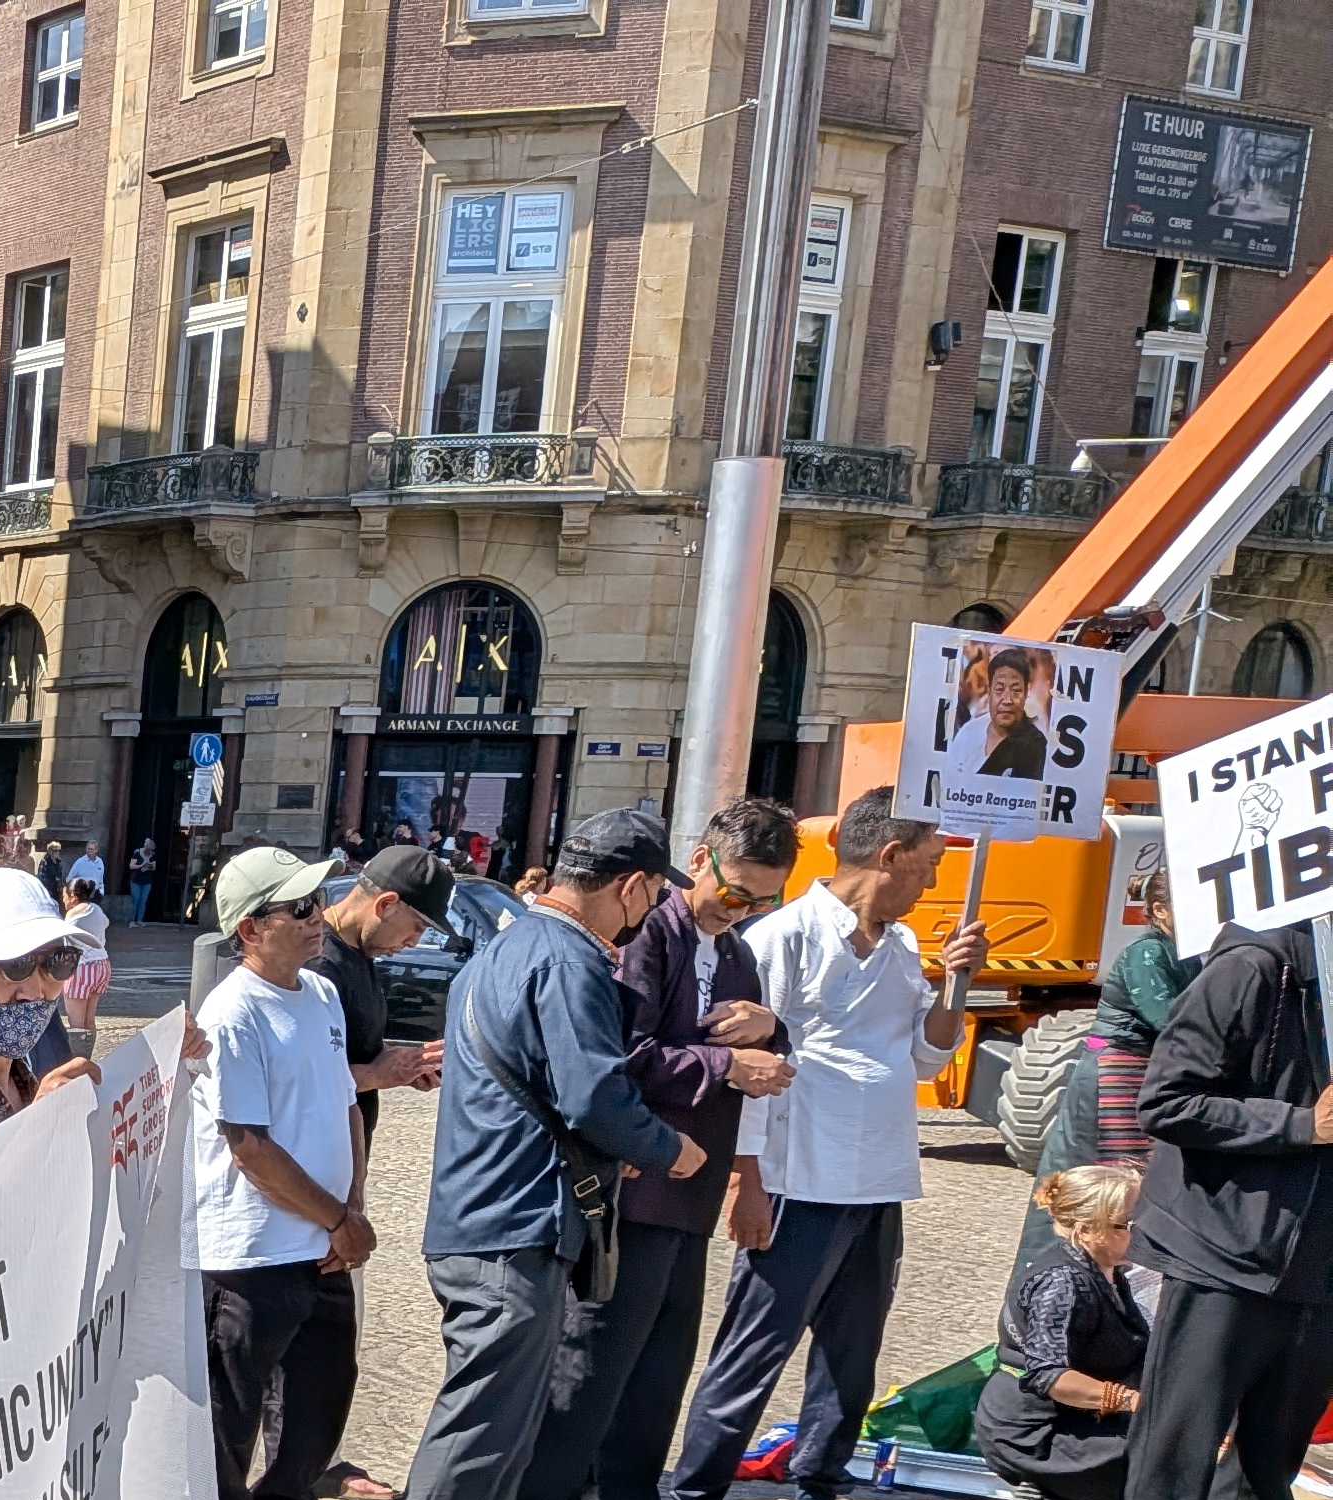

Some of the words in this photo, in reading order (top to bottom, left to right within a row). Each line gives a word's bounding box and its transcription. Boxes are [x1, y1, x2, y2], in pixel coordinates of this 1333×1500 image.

[1143, 111, 1162, 134] TE
[1164, 115, 1205, 139] HUUR
[456, 204, 497, 218] HEY
[455, 219, 496, 233] LIG
[454, 233, 494, 248] ERS
[387, 720, 441, 732] ARMANI
[446, 720, 521, 732] EXCHANGE
[1188, 769, 1200, 804] I
[1211, 716, 1333, 793] STAN
[946, 787, 983, 808] Lobga
[985, 791, 1037, 811] Rangzen
[139, 1063, 161, 1093] TIBET
[141, 1075, 174, 1116] SUPPORT
